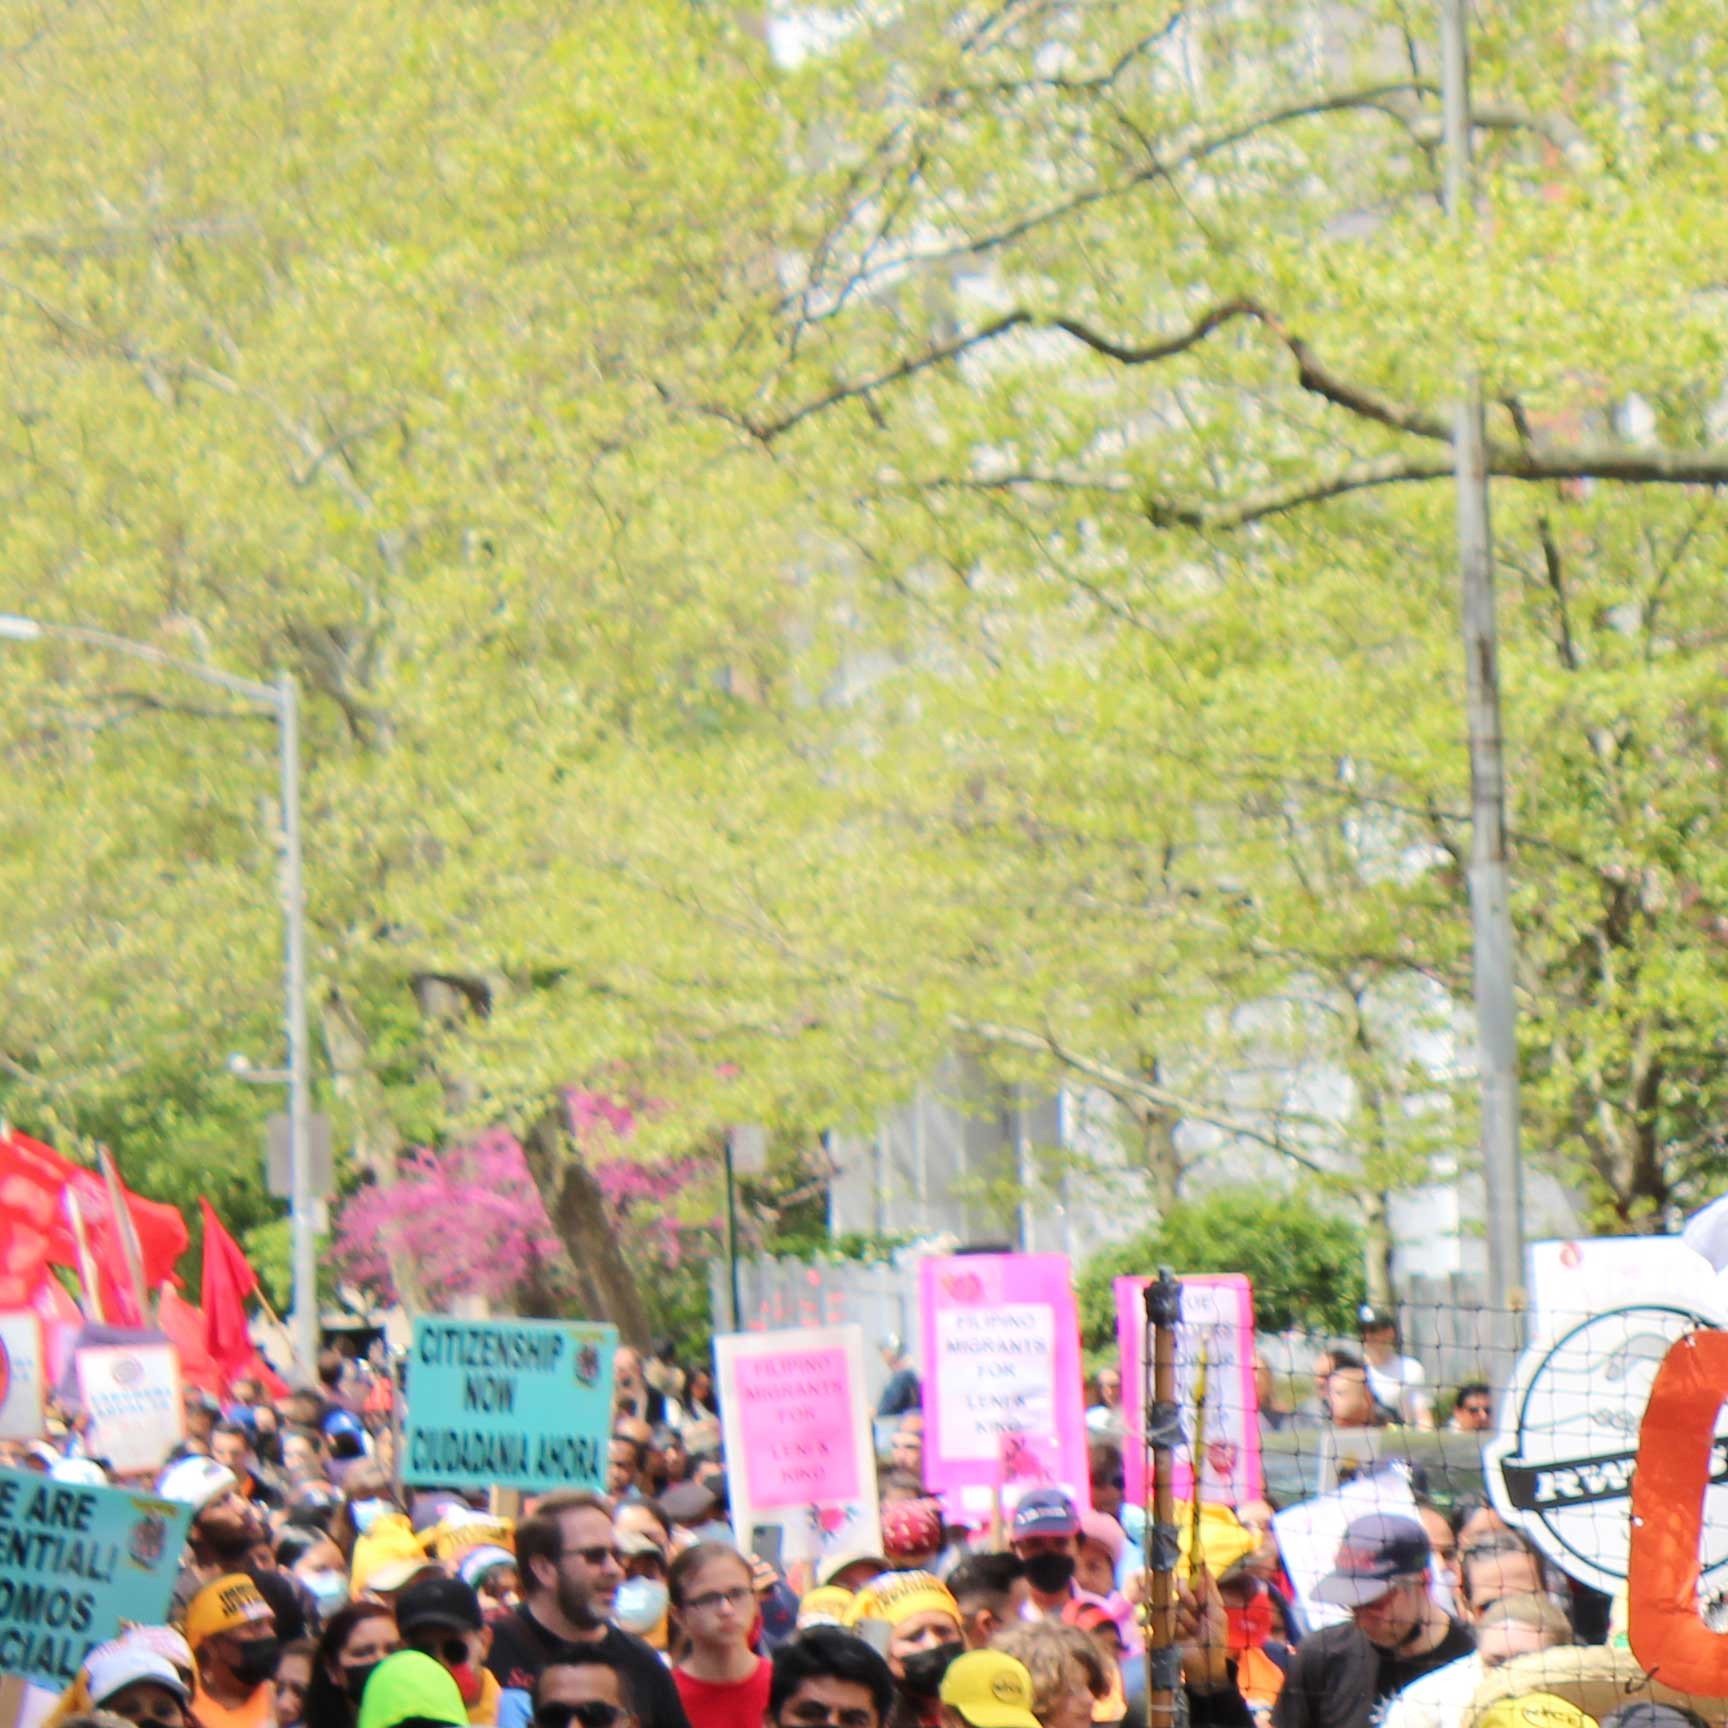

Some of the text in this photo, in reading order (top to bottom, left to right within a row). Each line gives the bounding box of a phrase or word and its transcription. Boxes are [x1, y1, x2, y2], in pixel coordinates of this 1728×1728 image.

[421, 1324, 565, 1372] CITIZENSHIP
[464, 1371, 517, 1415] NOW
[536, 1434, 600, 1480] AHORA
[25, 1488, 98, 1534] ARE
